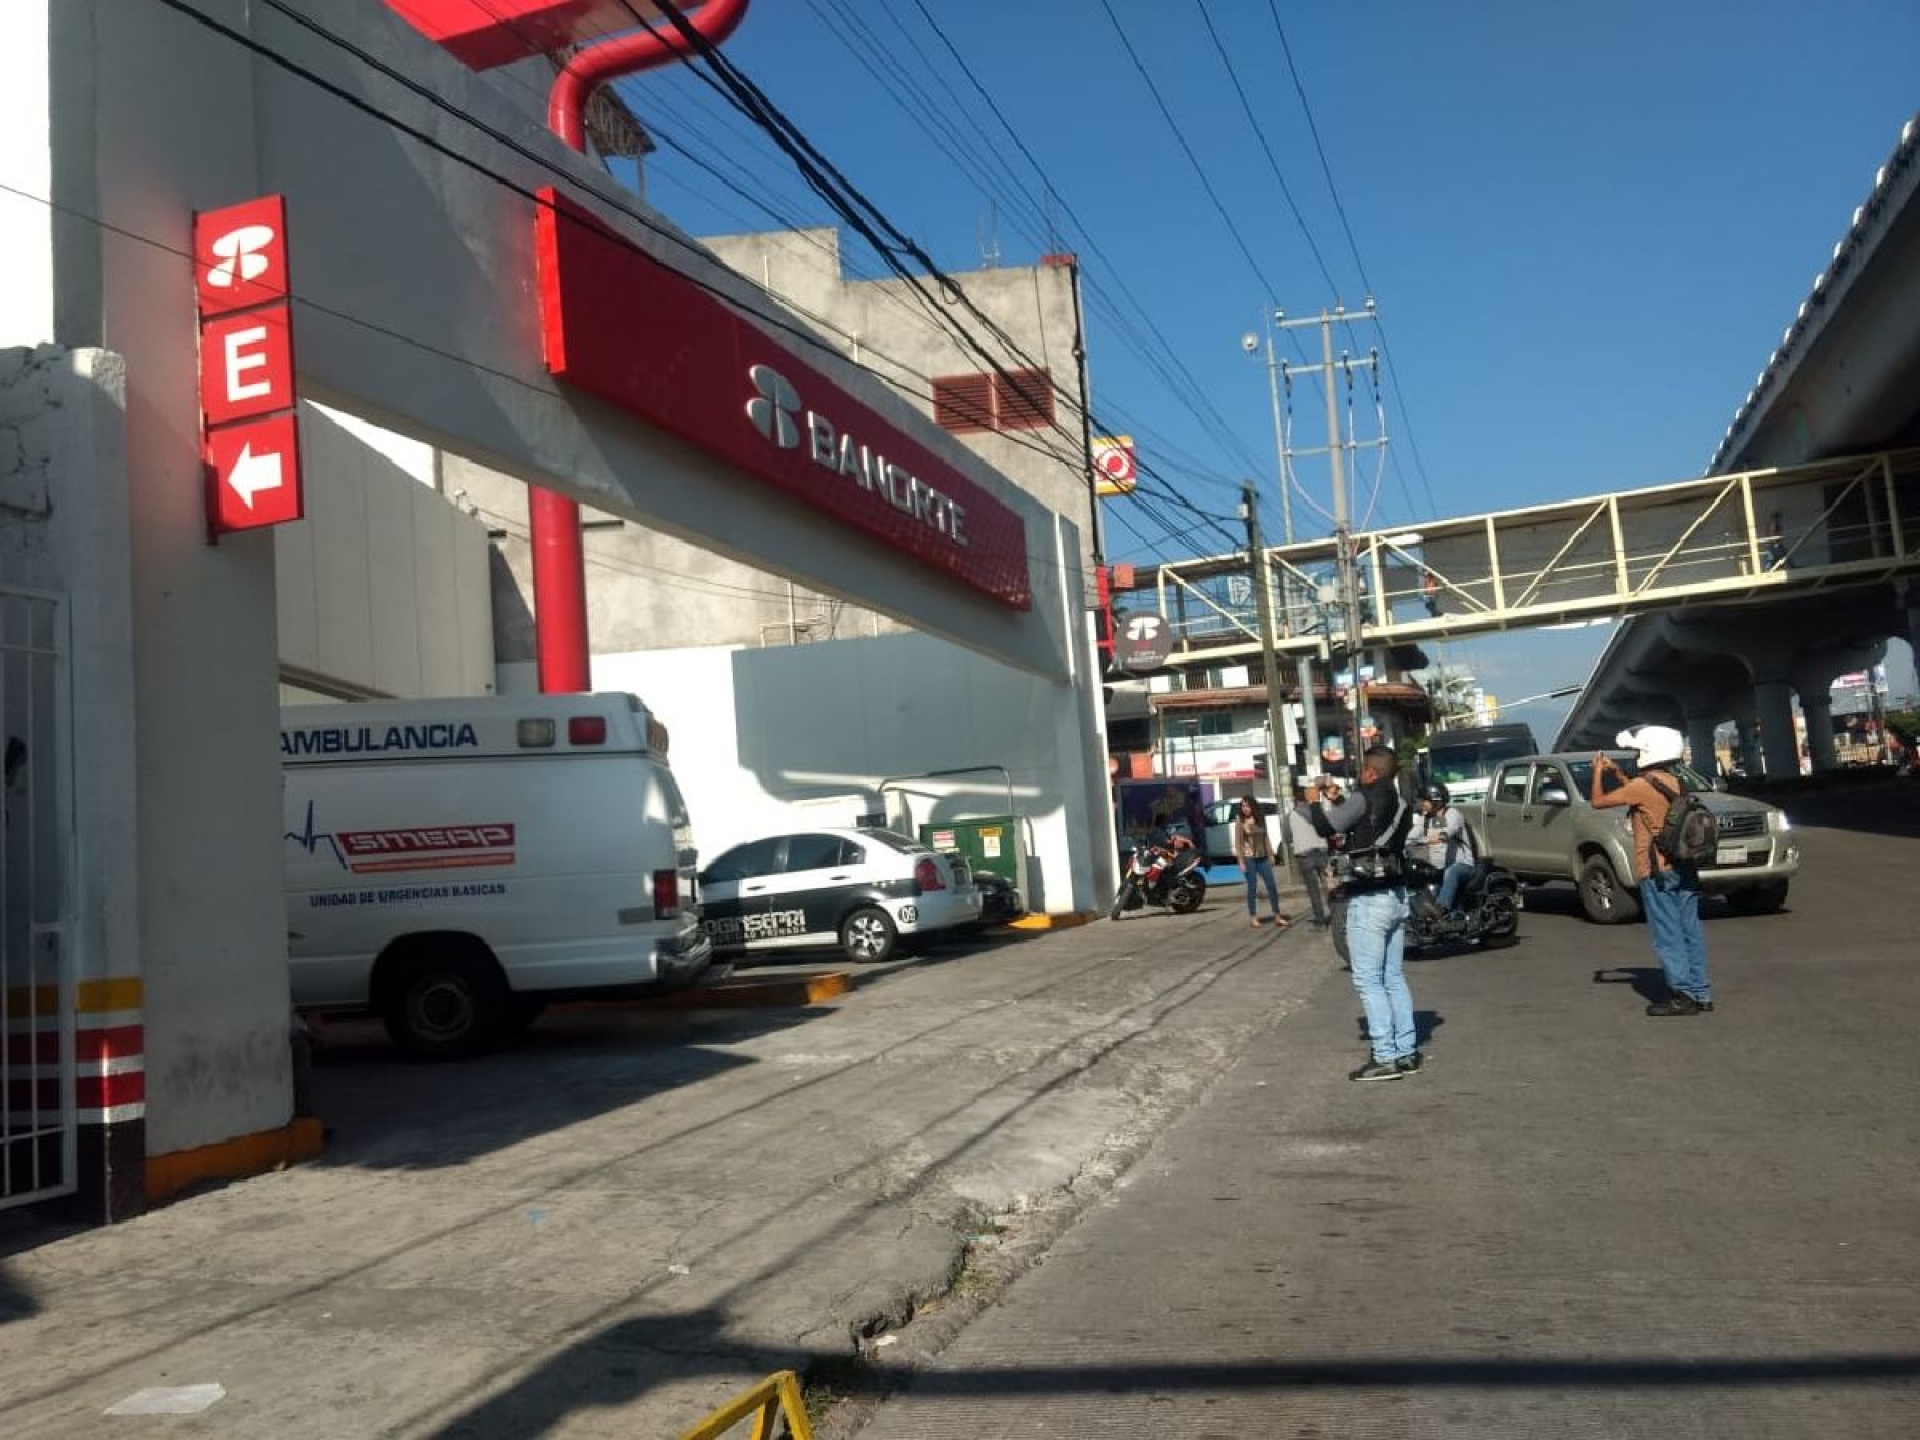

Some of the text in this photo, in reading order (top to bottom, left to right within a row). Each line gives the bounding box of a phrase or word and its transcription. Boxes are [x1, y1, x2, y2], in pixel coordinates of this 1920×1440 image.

[225, 326, 271, 402] E
[807, 410, 969, 546] BANORTE
[281, 723, 478, 755] AMBULANCIA
[309, 882, 506, 908] UNIDAD DE URGENCIAS BASICAS
